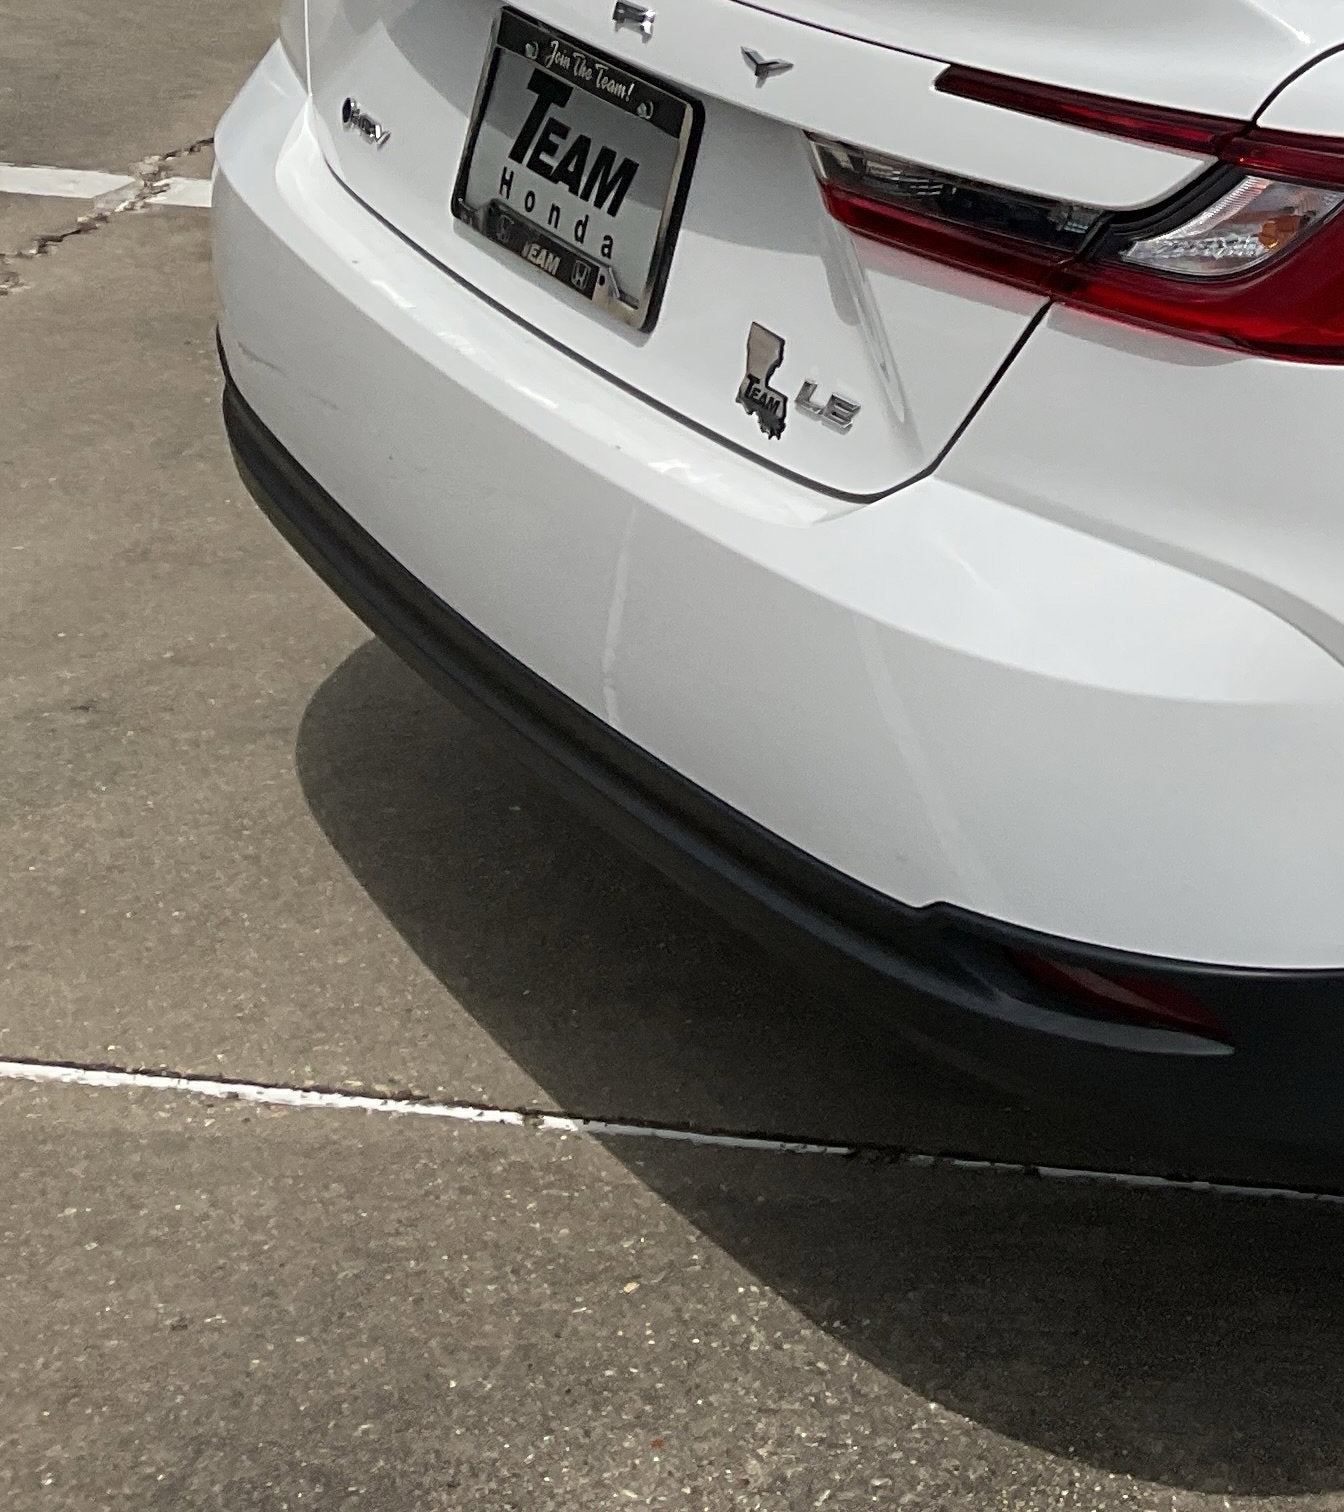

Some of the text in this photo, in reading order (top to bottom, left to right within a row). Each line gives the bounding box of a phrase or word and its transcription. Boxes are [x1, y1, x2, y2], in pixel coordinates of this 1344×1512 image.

[546, 40, 635, 103] Join The Team!
[508, 67, 640, 218] TEAM
[499, 166, 614, 260] Honda
[744, 373, 781, 414] TEAM
[794, 380, 862, 429] LE
